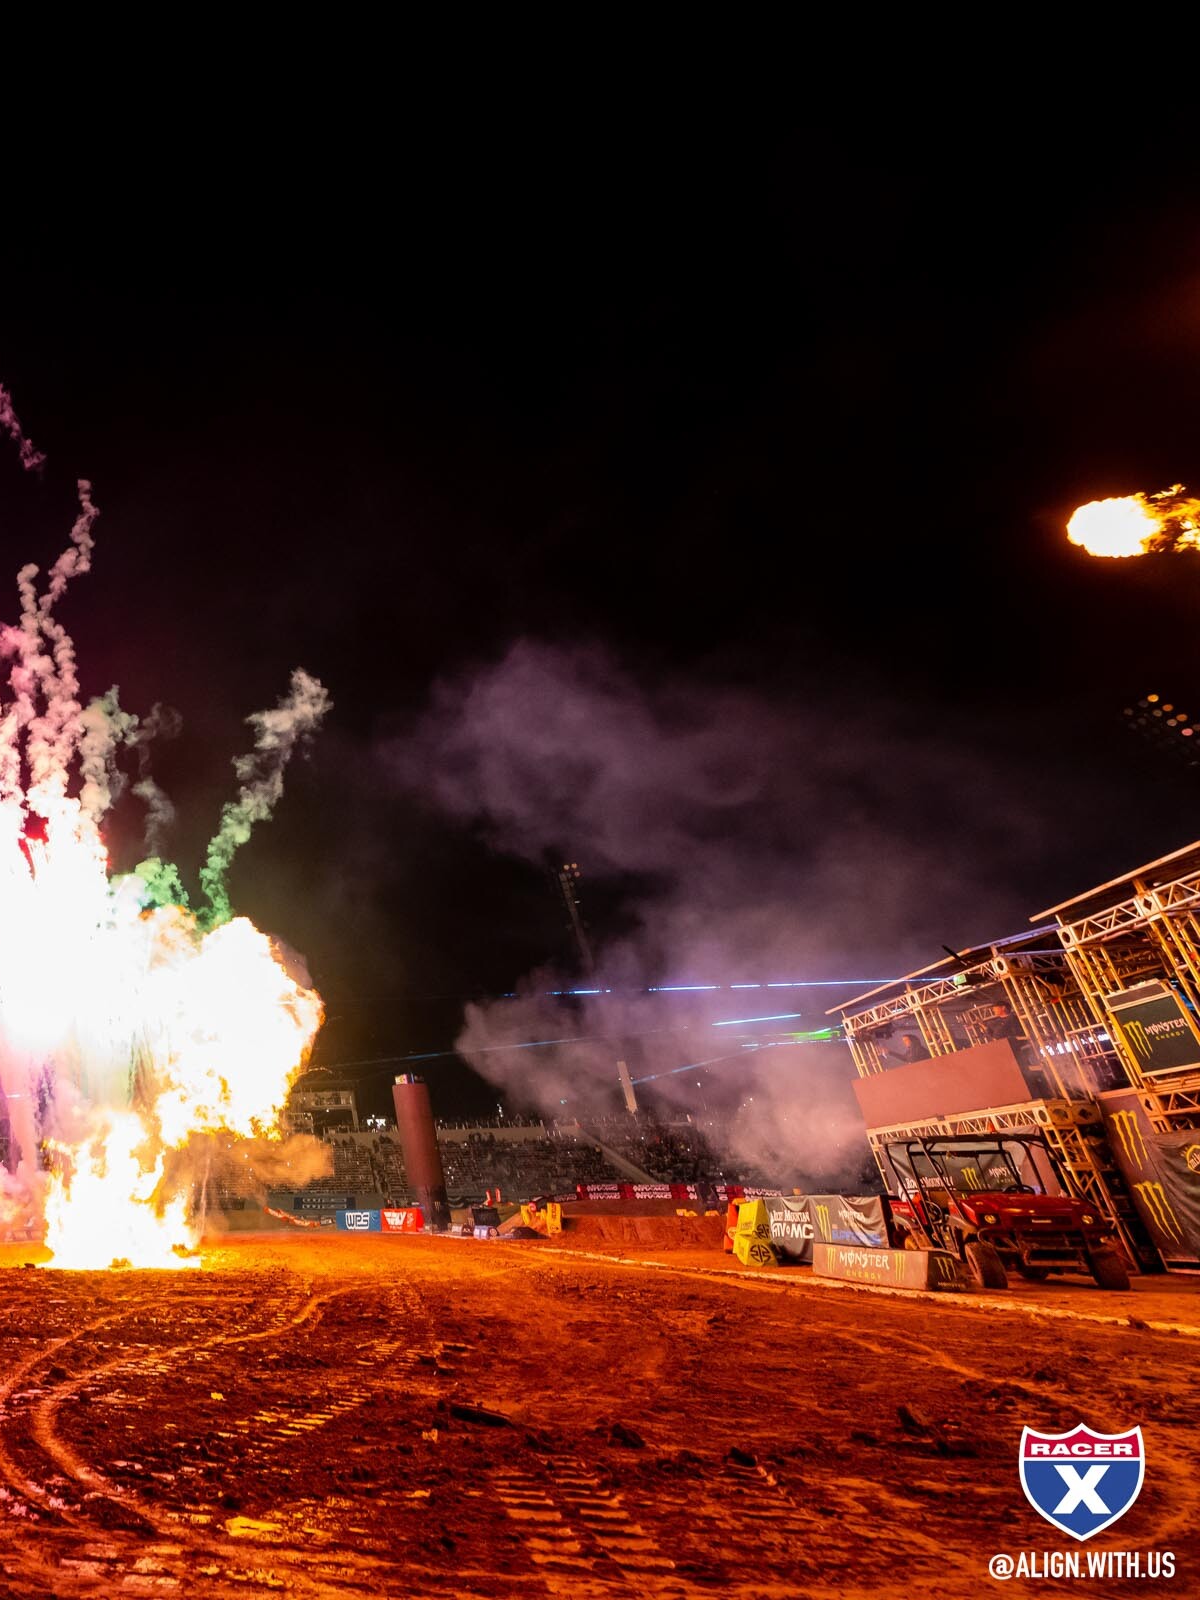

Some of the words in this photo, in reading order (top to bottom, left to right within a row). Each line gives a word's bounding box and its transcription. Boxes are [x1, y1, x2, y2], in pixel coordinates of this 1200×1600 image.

[1144, 1017, 1188, 1036] MONSTER
[1155, 1030, 1186, 1041] ENERGY
[988, 1166, 1021, 1177] MONSTR
[345, 1211, 370, 1229] WPS
[839, 1250, 890, 1270] MONSTER
[845, 1270, 882, 1280] ENERGY
